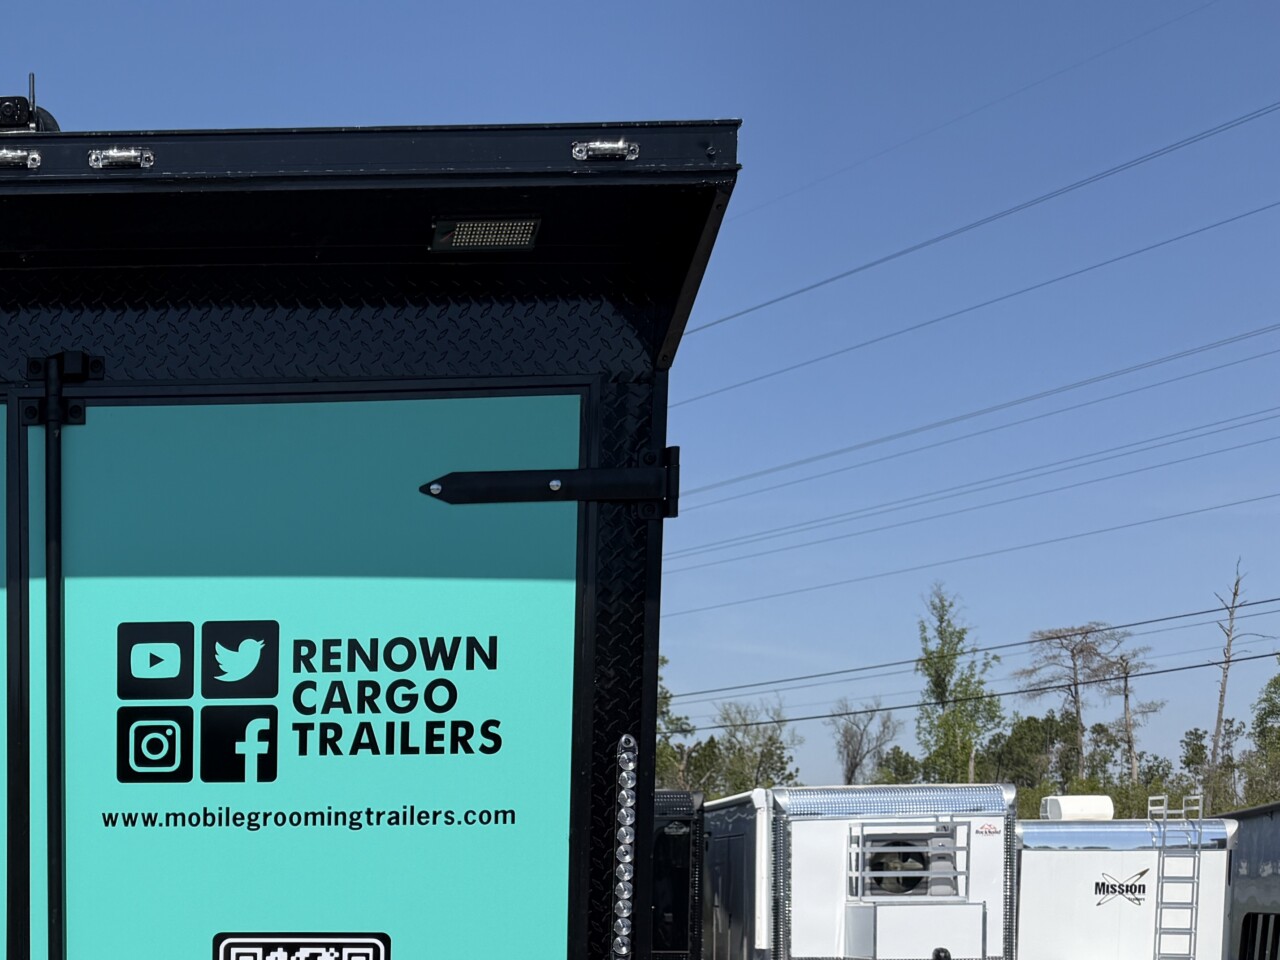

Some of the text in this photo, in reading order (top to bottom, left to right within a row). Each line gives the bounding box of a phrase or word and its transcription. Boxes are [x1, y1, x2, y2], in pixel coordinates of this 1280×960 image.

[292, 636, 498, 674] RENOWN
[292, 678, 458, 715] CARGO
[292, 719, 503, 756] TRAILERS
[101, 805, 517, 831] www.mobilegroomingtrailers.com
